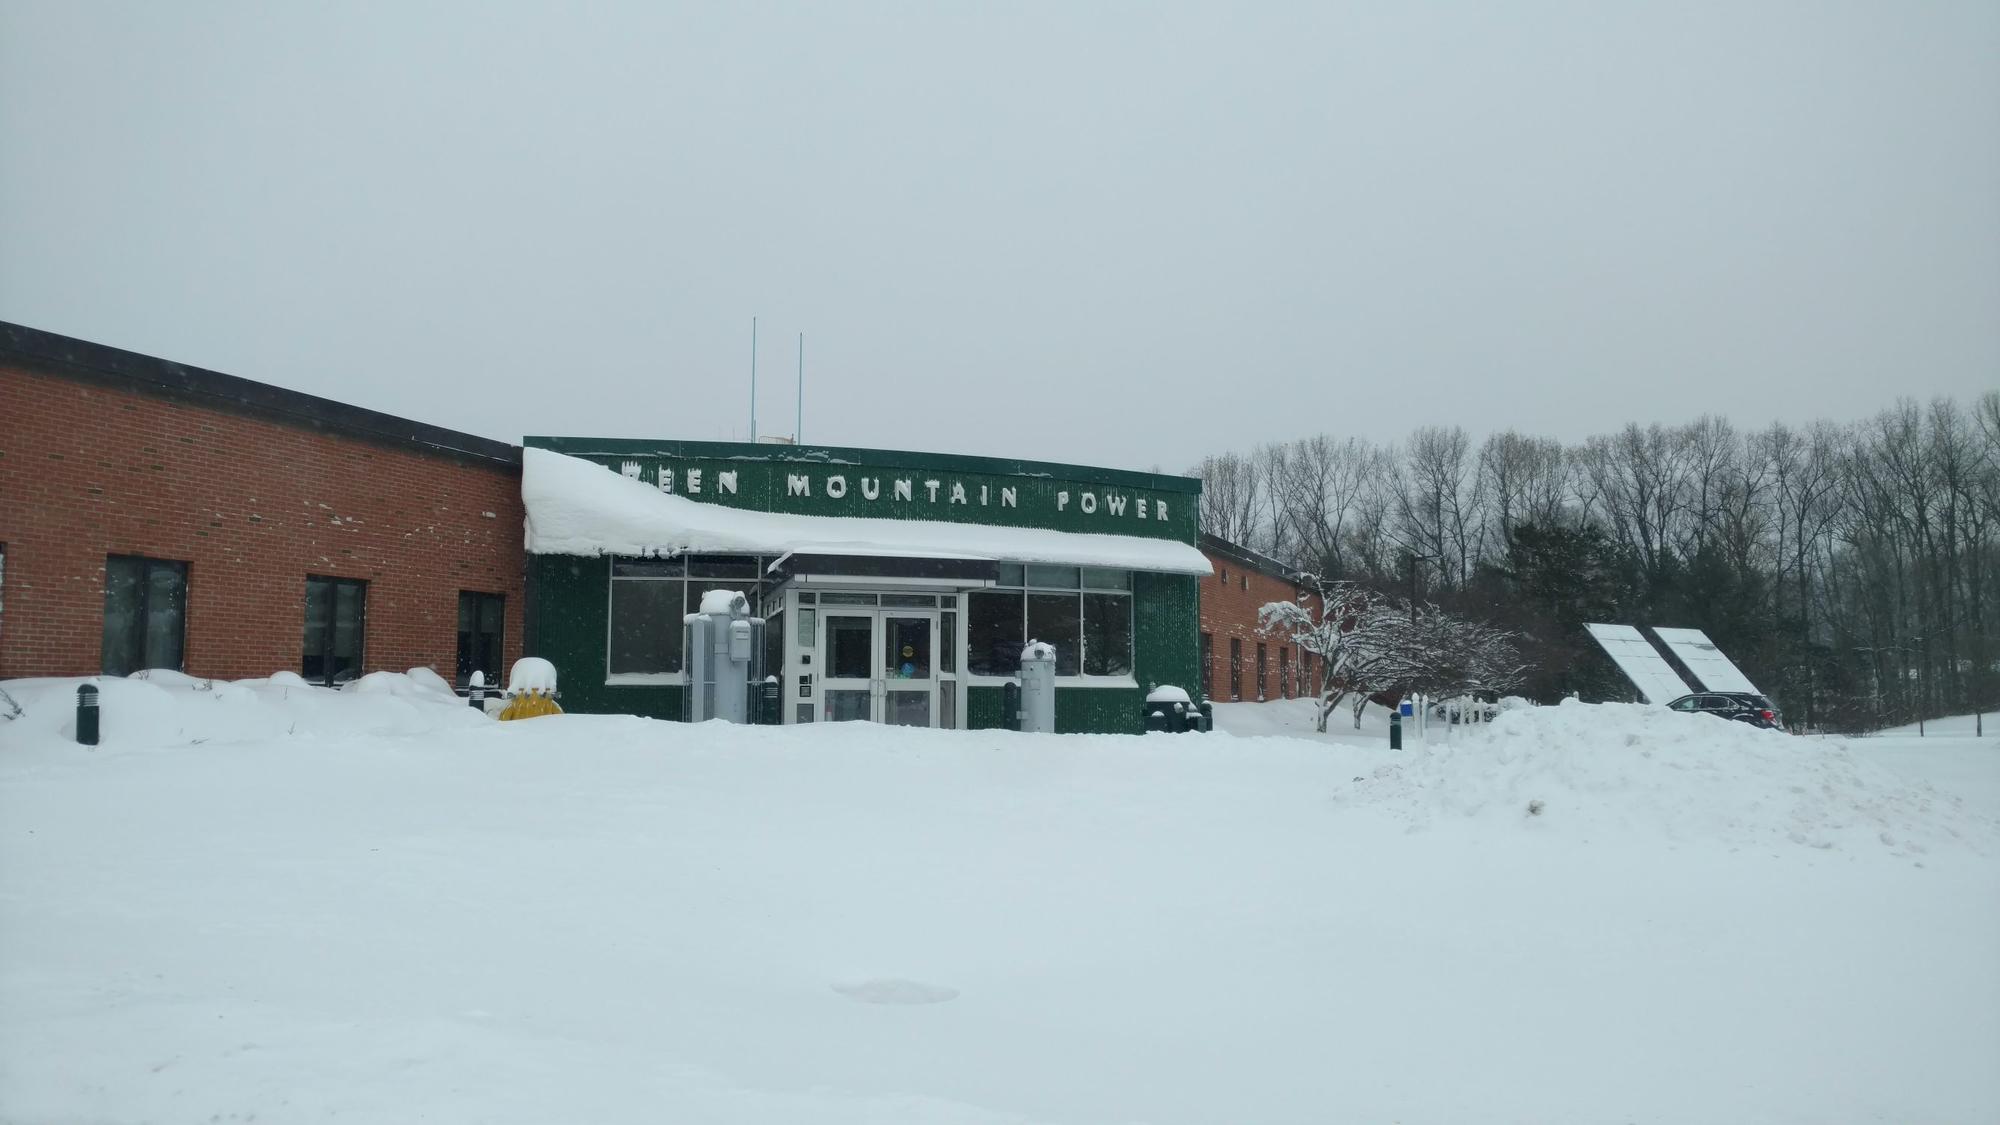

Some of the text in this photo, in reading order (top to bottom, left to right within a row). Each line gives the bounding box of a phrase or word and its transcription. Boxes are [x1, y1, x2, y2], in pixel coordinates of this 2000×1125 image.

[620, 460, 1169, 521] REEN MOUNTAIN POWER
